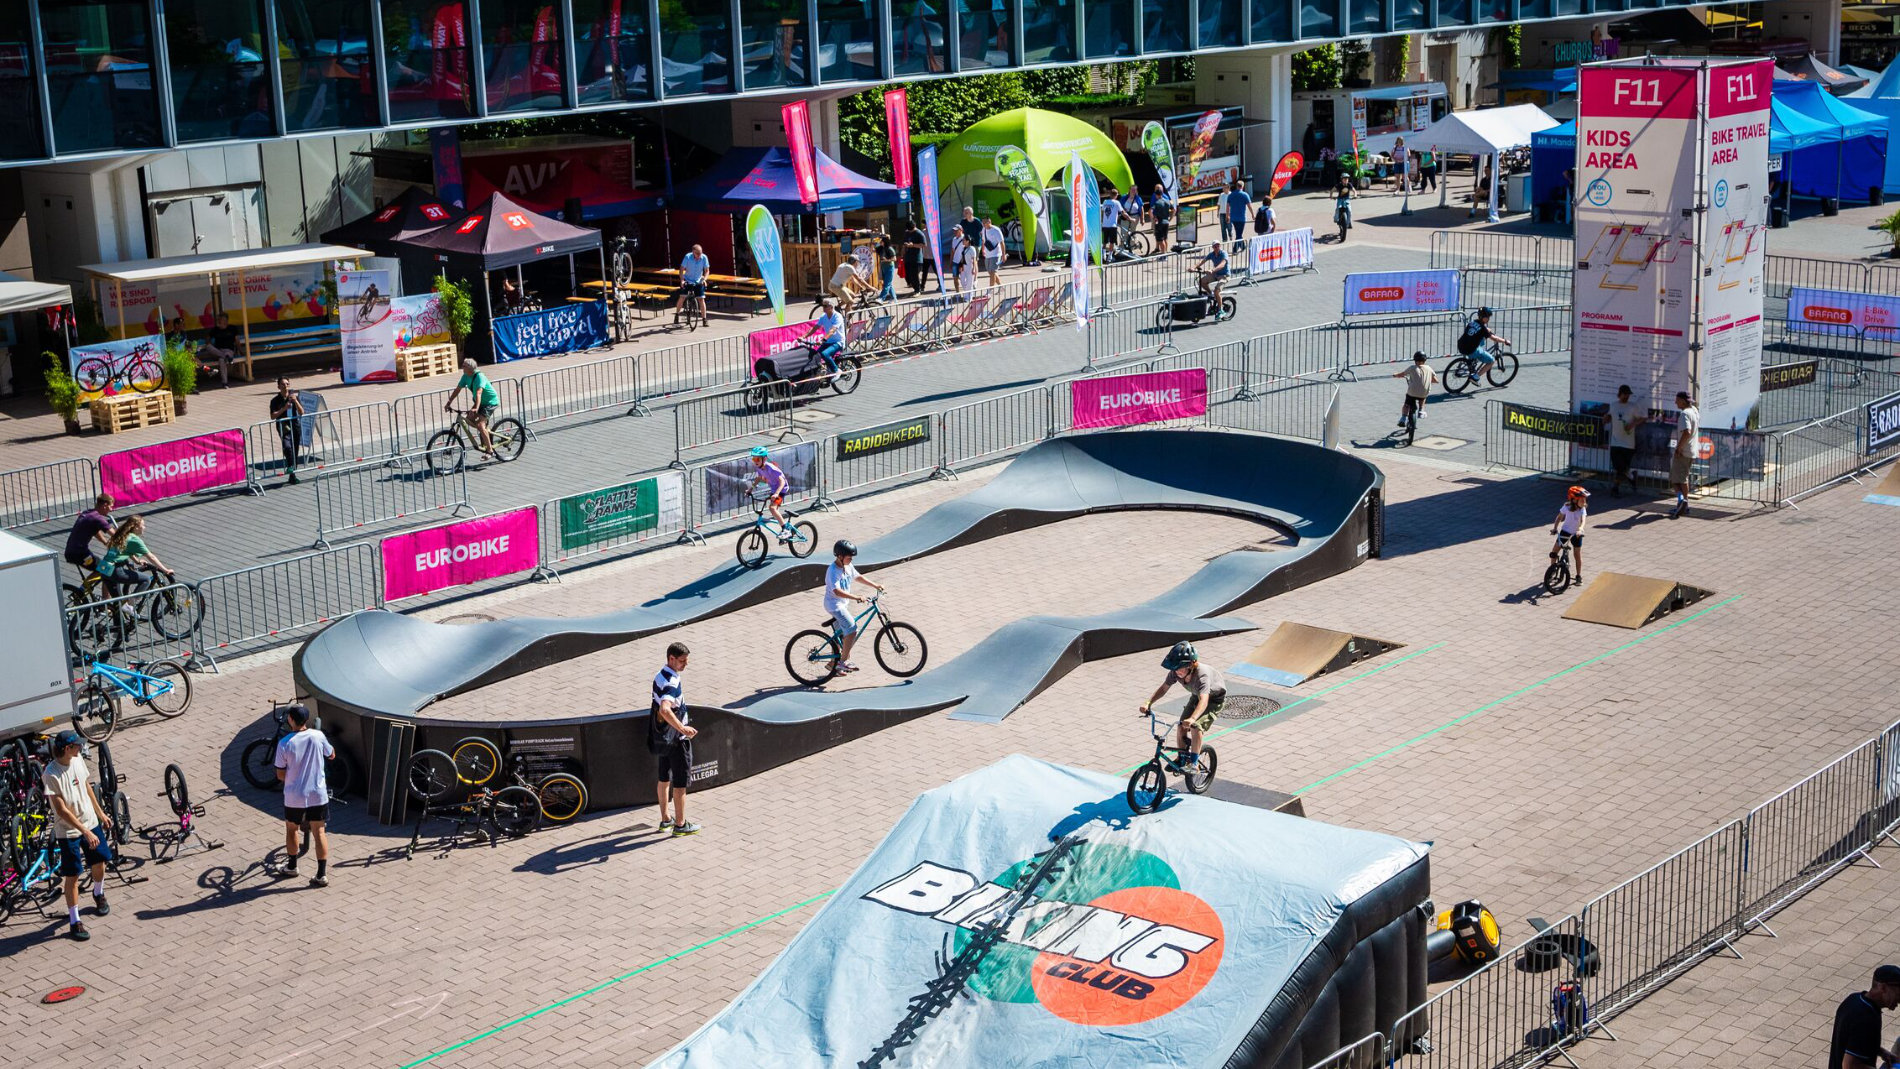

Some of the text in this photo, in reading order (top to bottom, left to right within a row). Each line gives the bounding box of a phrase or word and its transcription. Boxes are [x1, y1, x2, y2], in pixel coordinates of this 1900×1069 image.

[1555, 40, 1593, 62] CHURROS
[1613, 78, 1663, 106] F11
[1727, 73, 1757, 103] F11
[1586, 129, 1631, 147] KIDS
[1711, 123, 1766, 146] BIKE TRAVEL
[1585, 151, 1638, 170] AREA
[1711, 148, 1738, 166] AREA
[227, 274, 272, 286] EUOBIKE
[1364, 290, 1399, 299] BAFANG
[548, 310, 577, 330] free
[1581, 312, 1624, 321] PROGRAMM
[1809, 309, 1847, 320] BAFANG
[1864, 314, 1885, 324] Drive
[516, 336, 546, 356] ride
[1100, 388, 1181, 410] EUROBIKE
[844, 425, 925, 454] RADIOBIKECO.
[131, 452, 218, 485] EUROBIKE
[595, 500, 637, 519] RAMPS
[415, 535, 510, 572] EUROBIKE
[859, 860, 1219, 978] BIKING
[1047, 962, 1155, 1001] CLUB
